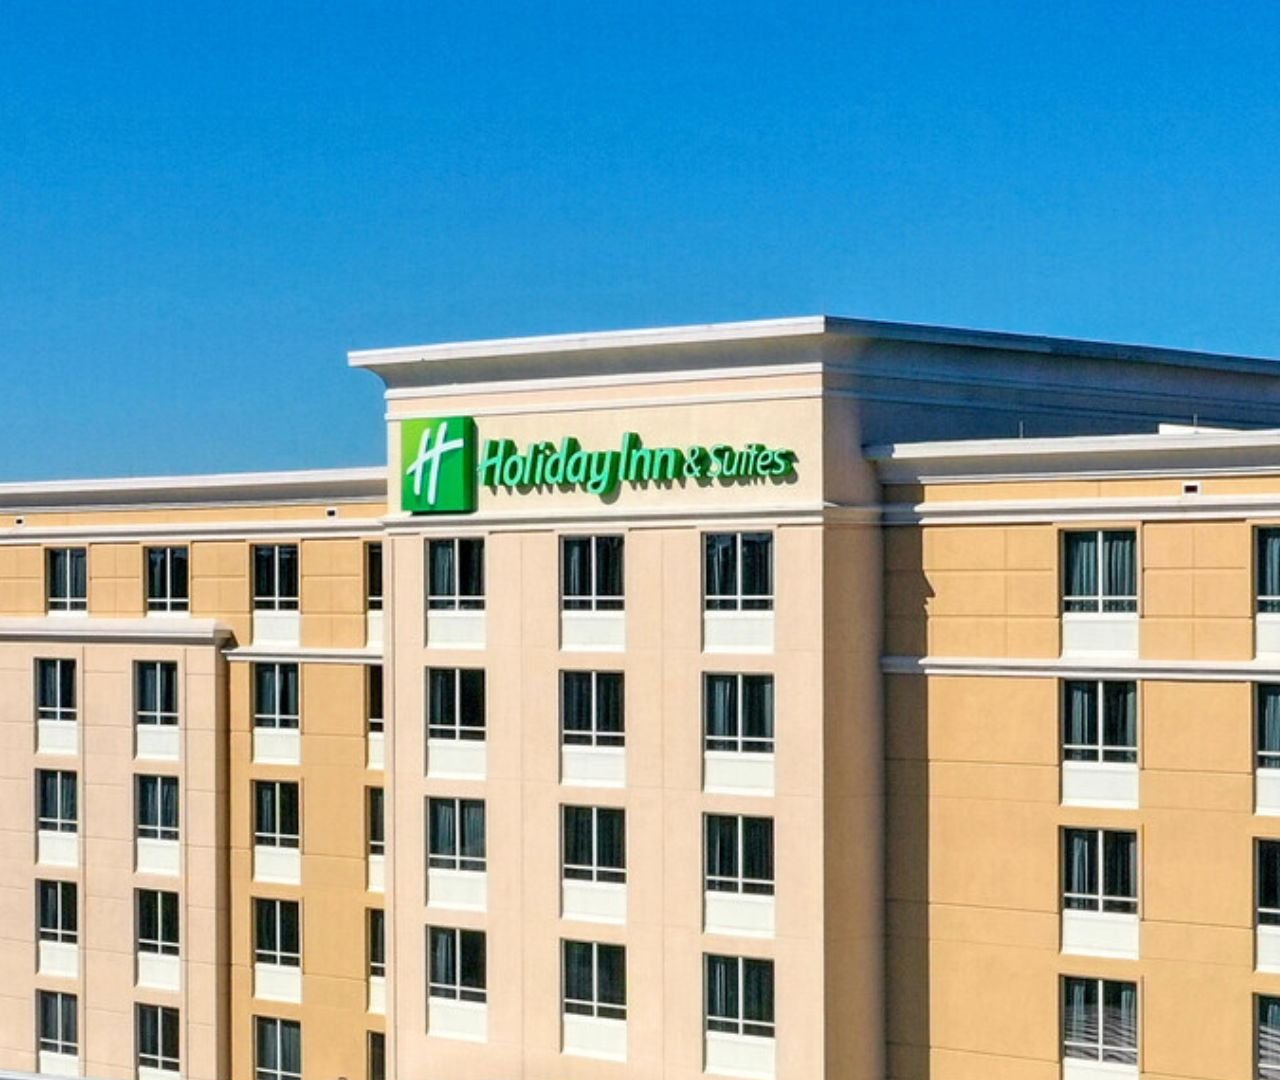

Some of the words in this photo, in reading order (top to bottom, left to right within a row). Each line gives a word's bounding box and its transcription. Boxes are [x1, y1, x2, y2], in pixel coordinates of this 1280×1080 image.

[477, 436, 616, 495] Holiday
[618, 432, 680, 480] Inn
[682, 444, 706, 478] &
[706, 443, 790, 477] Suites
